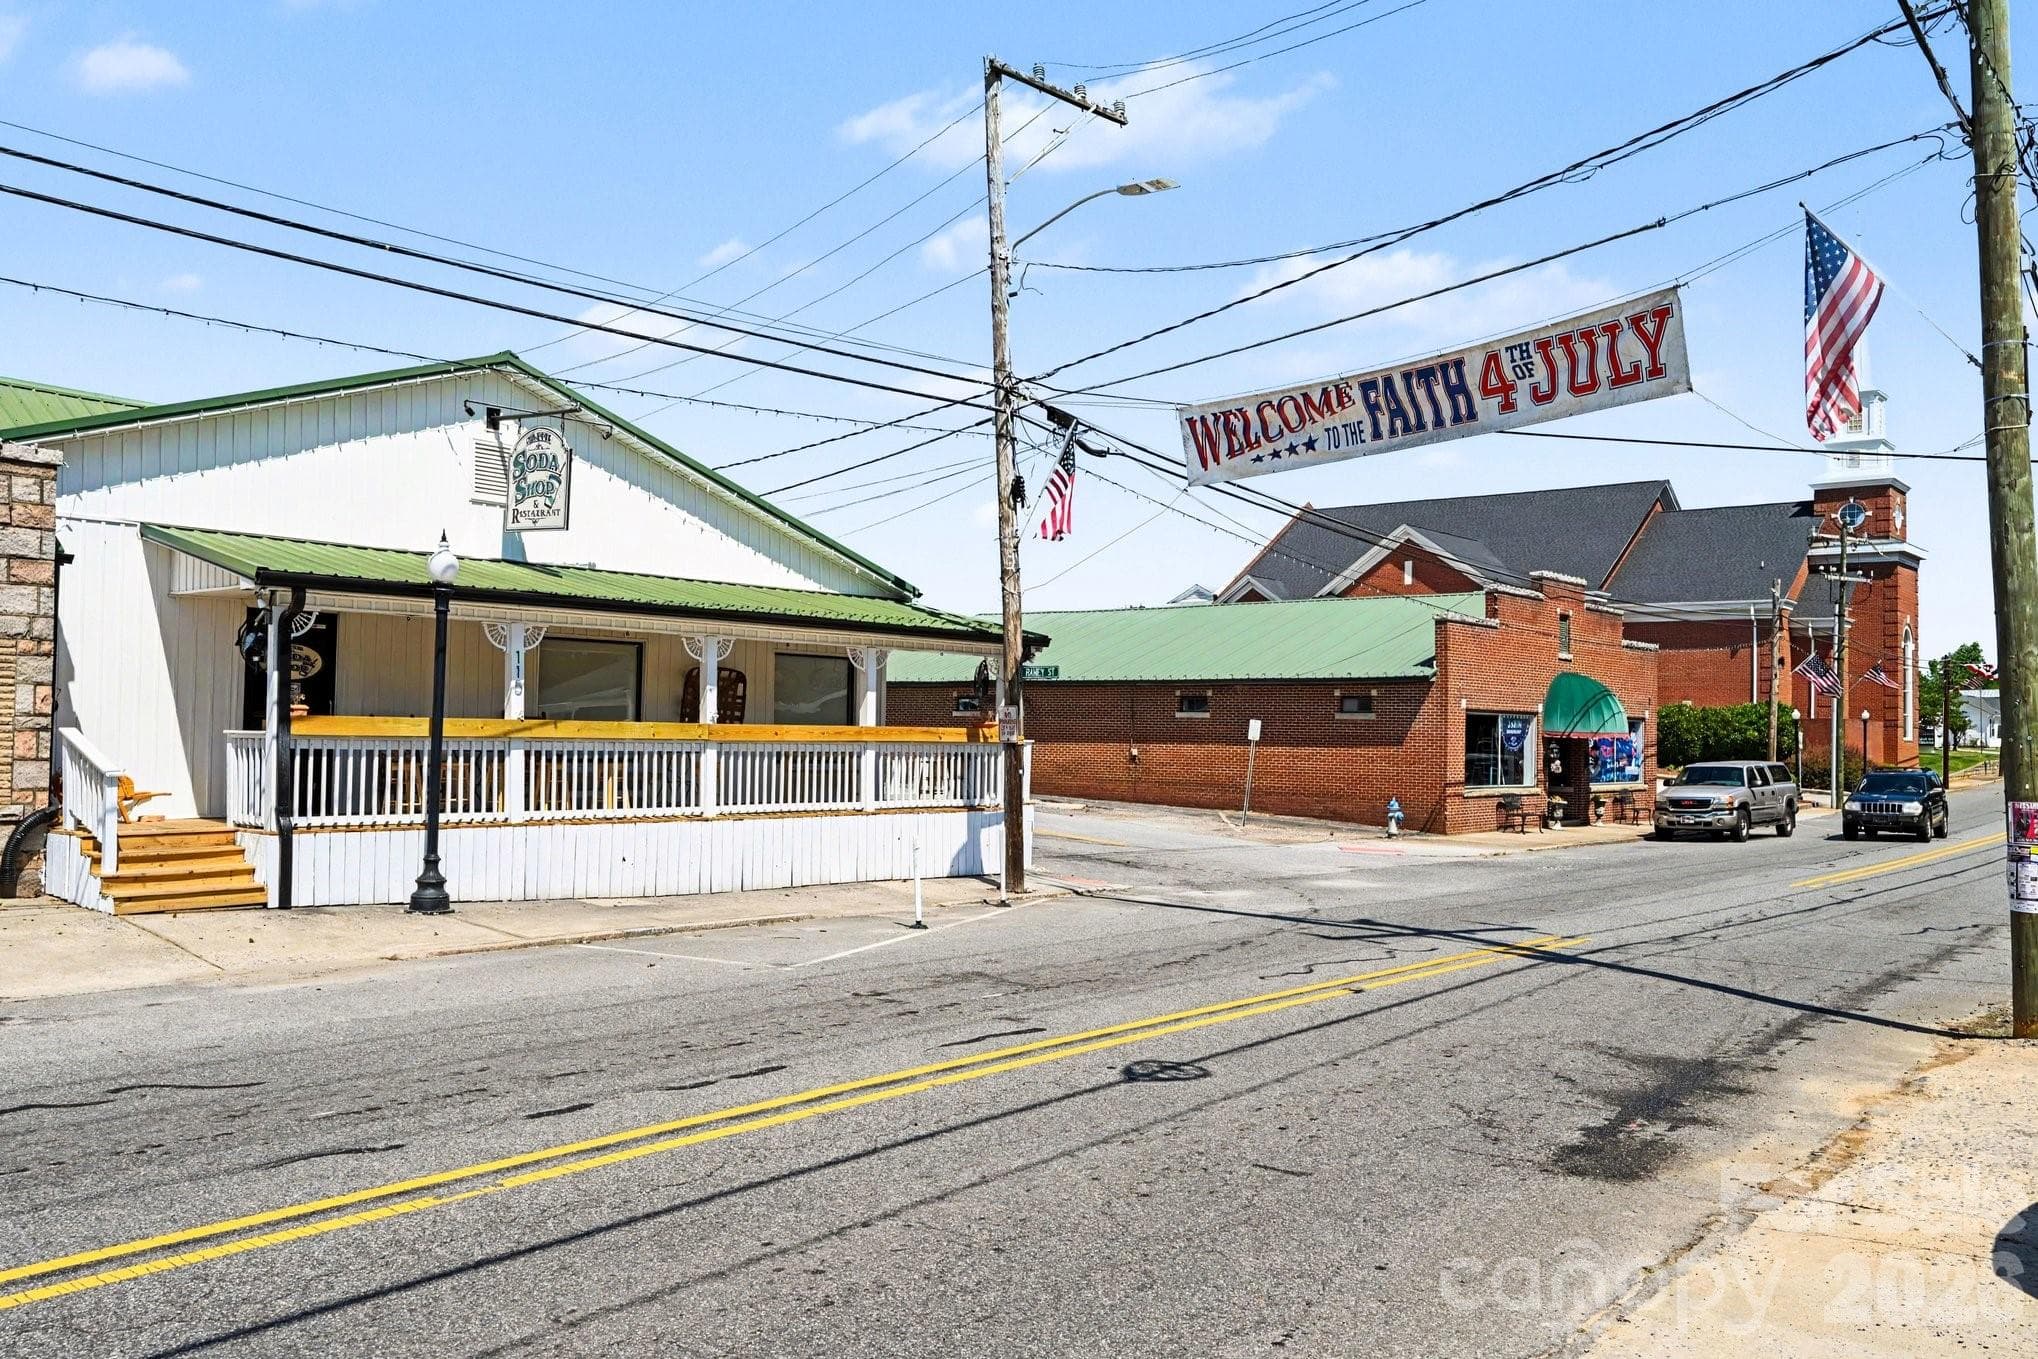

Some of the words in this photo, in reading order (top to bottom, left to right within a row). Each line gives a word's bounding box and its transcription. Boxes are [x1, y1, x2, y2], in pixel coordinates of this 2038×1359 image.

[1505, 341, 1533, 363] TH
[1529, 303, 1674, 406] JULY
[1479, 350, 1518, 415] 4
[1512, 361, 1536, 381] OF
[1357, 356, 1479, 442] FAITH
[1185, 382, 1356, 471] WELCOME
[1325, 427, 1341, 450] TO
[1341, 420, 1366, 447] THE
[512, 449, 559, 481] SODA
[513, 477, 555, 506] SHOP
